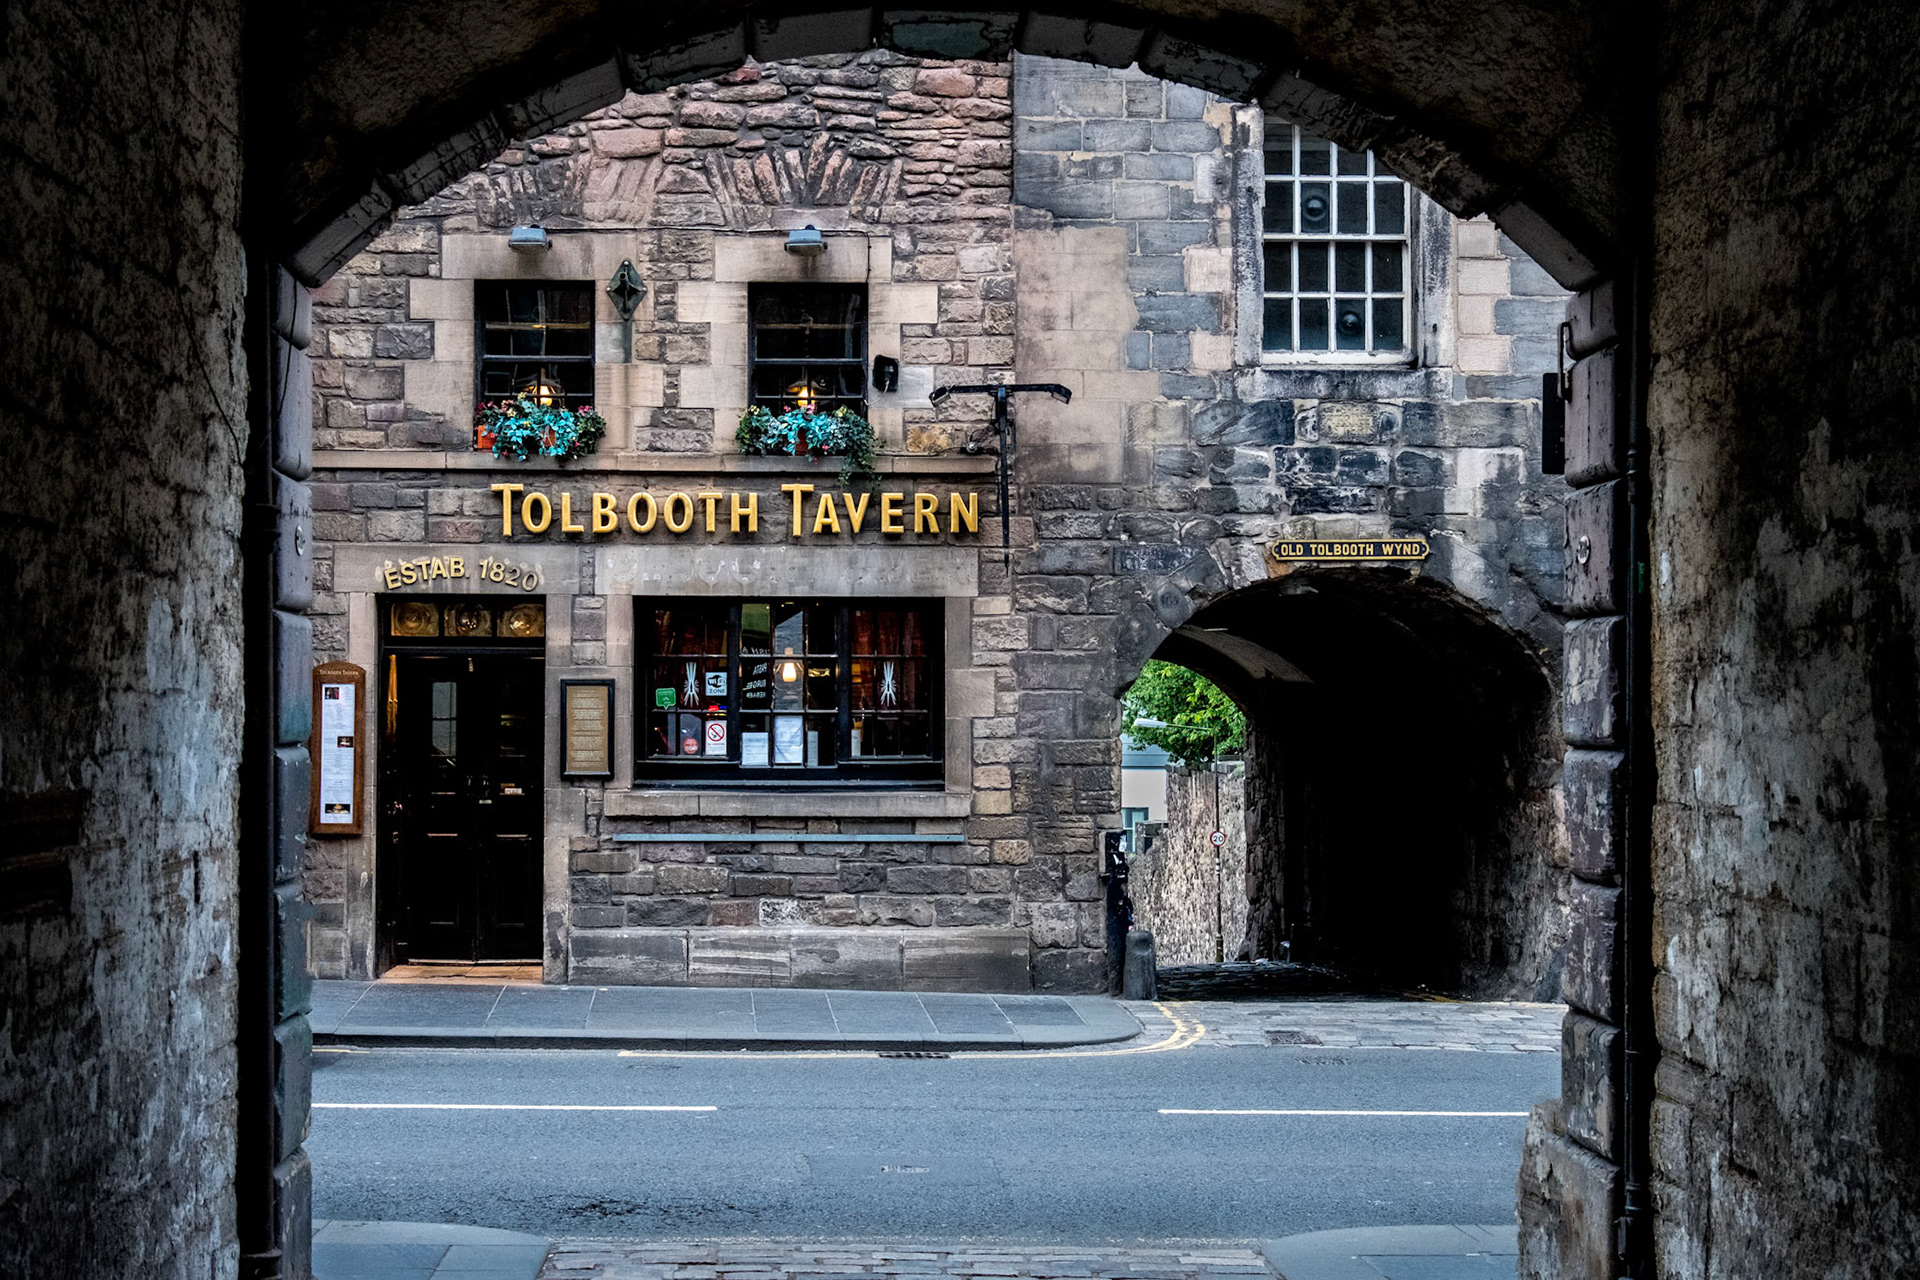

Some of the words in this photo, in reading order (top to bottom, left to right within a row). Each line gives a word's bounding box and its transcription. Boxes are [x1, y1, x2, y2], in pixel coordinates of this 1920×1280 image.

[490, 483, 758, 537] TOLBOOTH
[781, 483, 979, 537] TAVERN
[1280, 544, 1304, 556] OLD
[1310, 543, 1374, 556] TOLBOOTH
[1382, 543, 1420, 556] WYND
[384, 556, 470, 590] ESTAB.
[479, 558, 539, 592] 1820
[1212, 835, 1224, 843] 20
